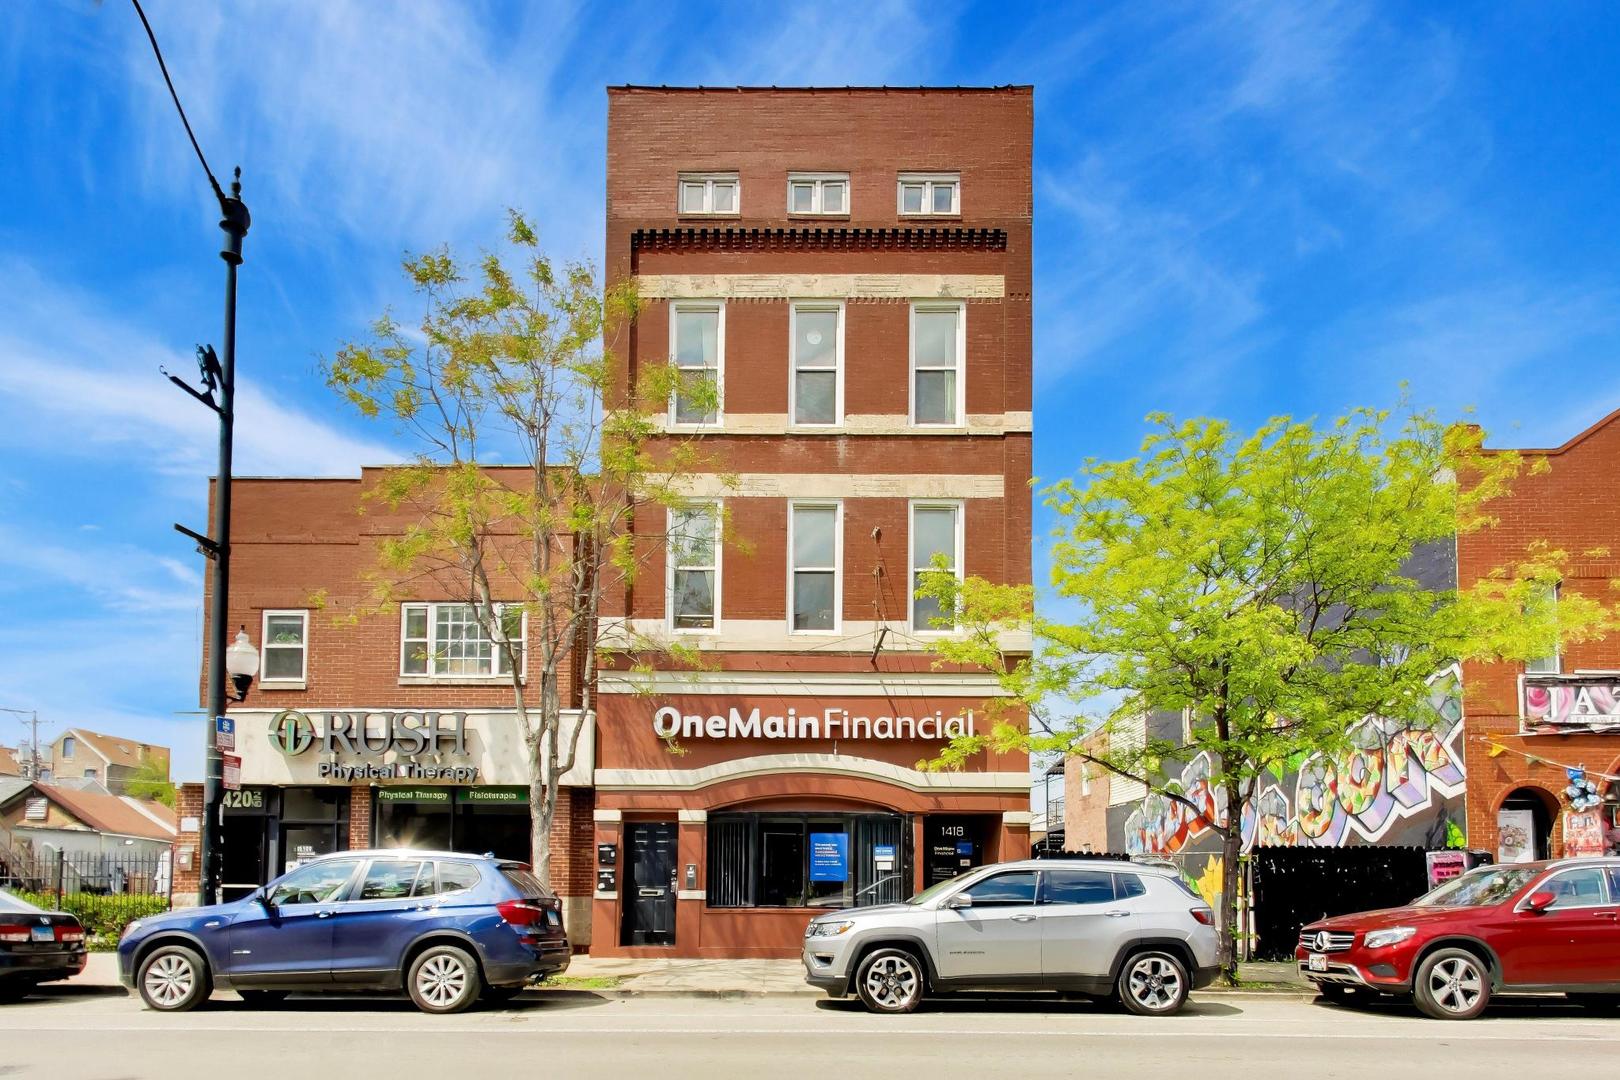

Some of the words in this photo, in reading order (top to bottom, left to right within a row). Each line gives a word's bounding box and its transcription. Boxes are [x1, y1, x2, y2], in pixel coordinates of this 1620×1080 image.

[319, 711, 470, 756] RUSH
[318, 763, 397, 782] Physical
[405, 763, 479, 783] Therapy
[378, 791, 413, 800] Physical
[415, 791, 448, 800] Therapy
[941, 826, 964, 837] 1418
